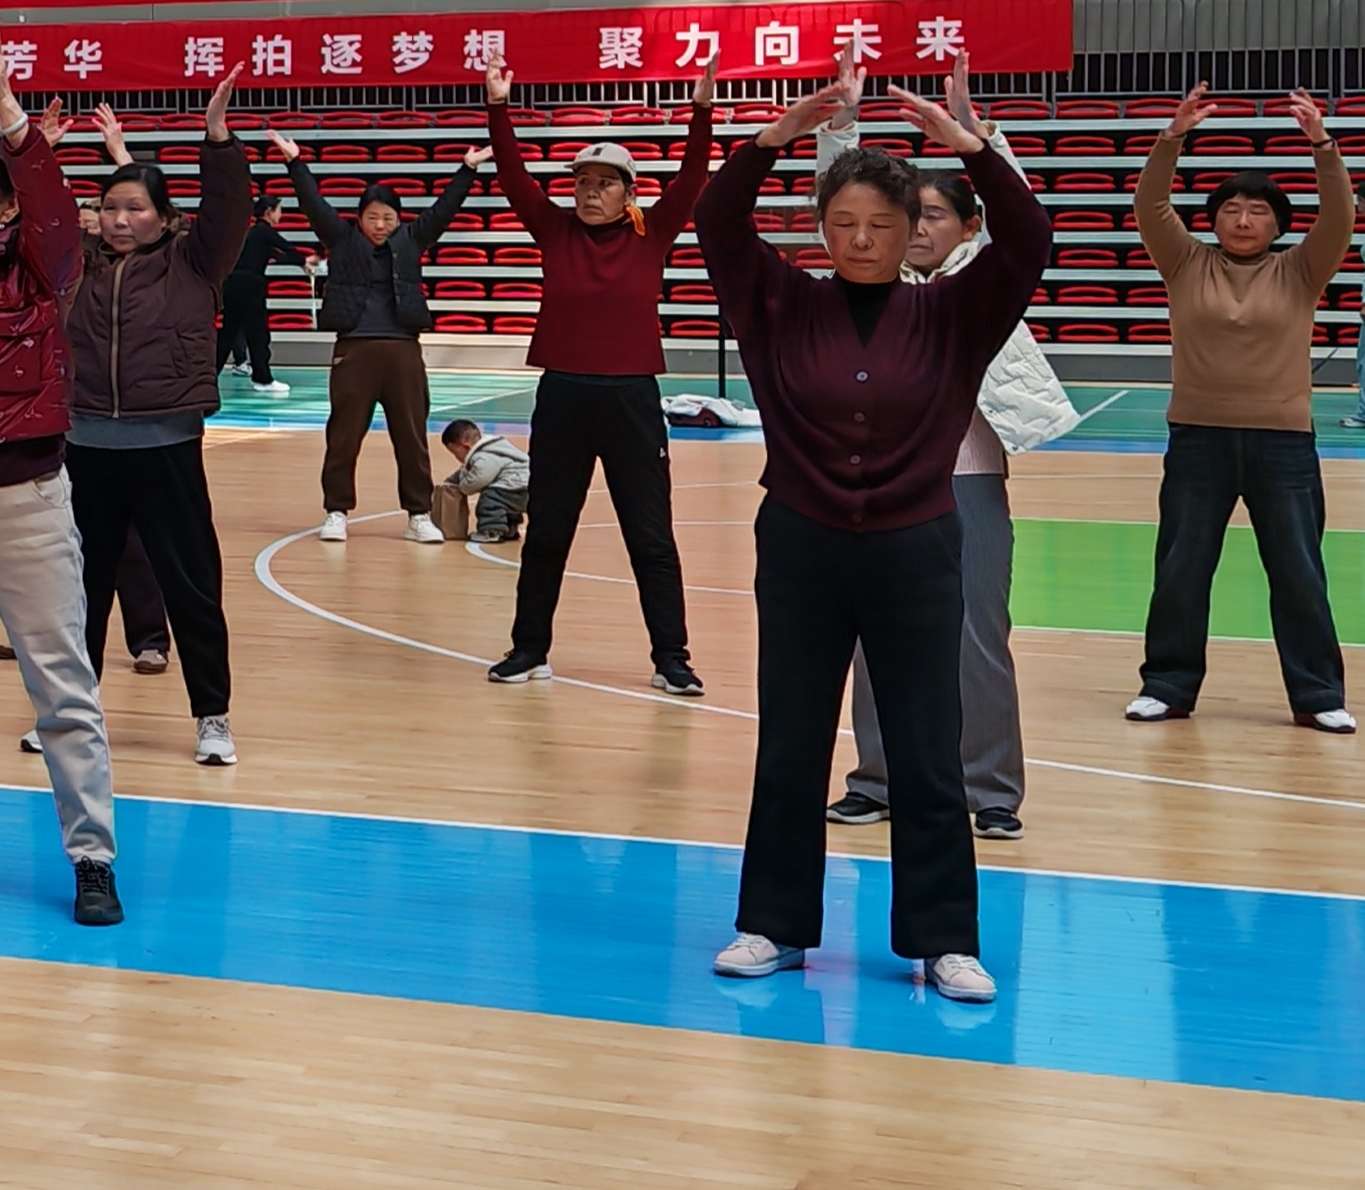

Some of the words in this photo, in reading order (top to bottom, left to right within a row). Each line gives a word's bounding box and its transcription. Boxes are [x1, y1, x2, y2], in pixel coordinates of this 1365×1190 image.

[184, 29, 507, 78] 挥拍逐梦想
[598, 15, 966, 70] 聚力向未来
